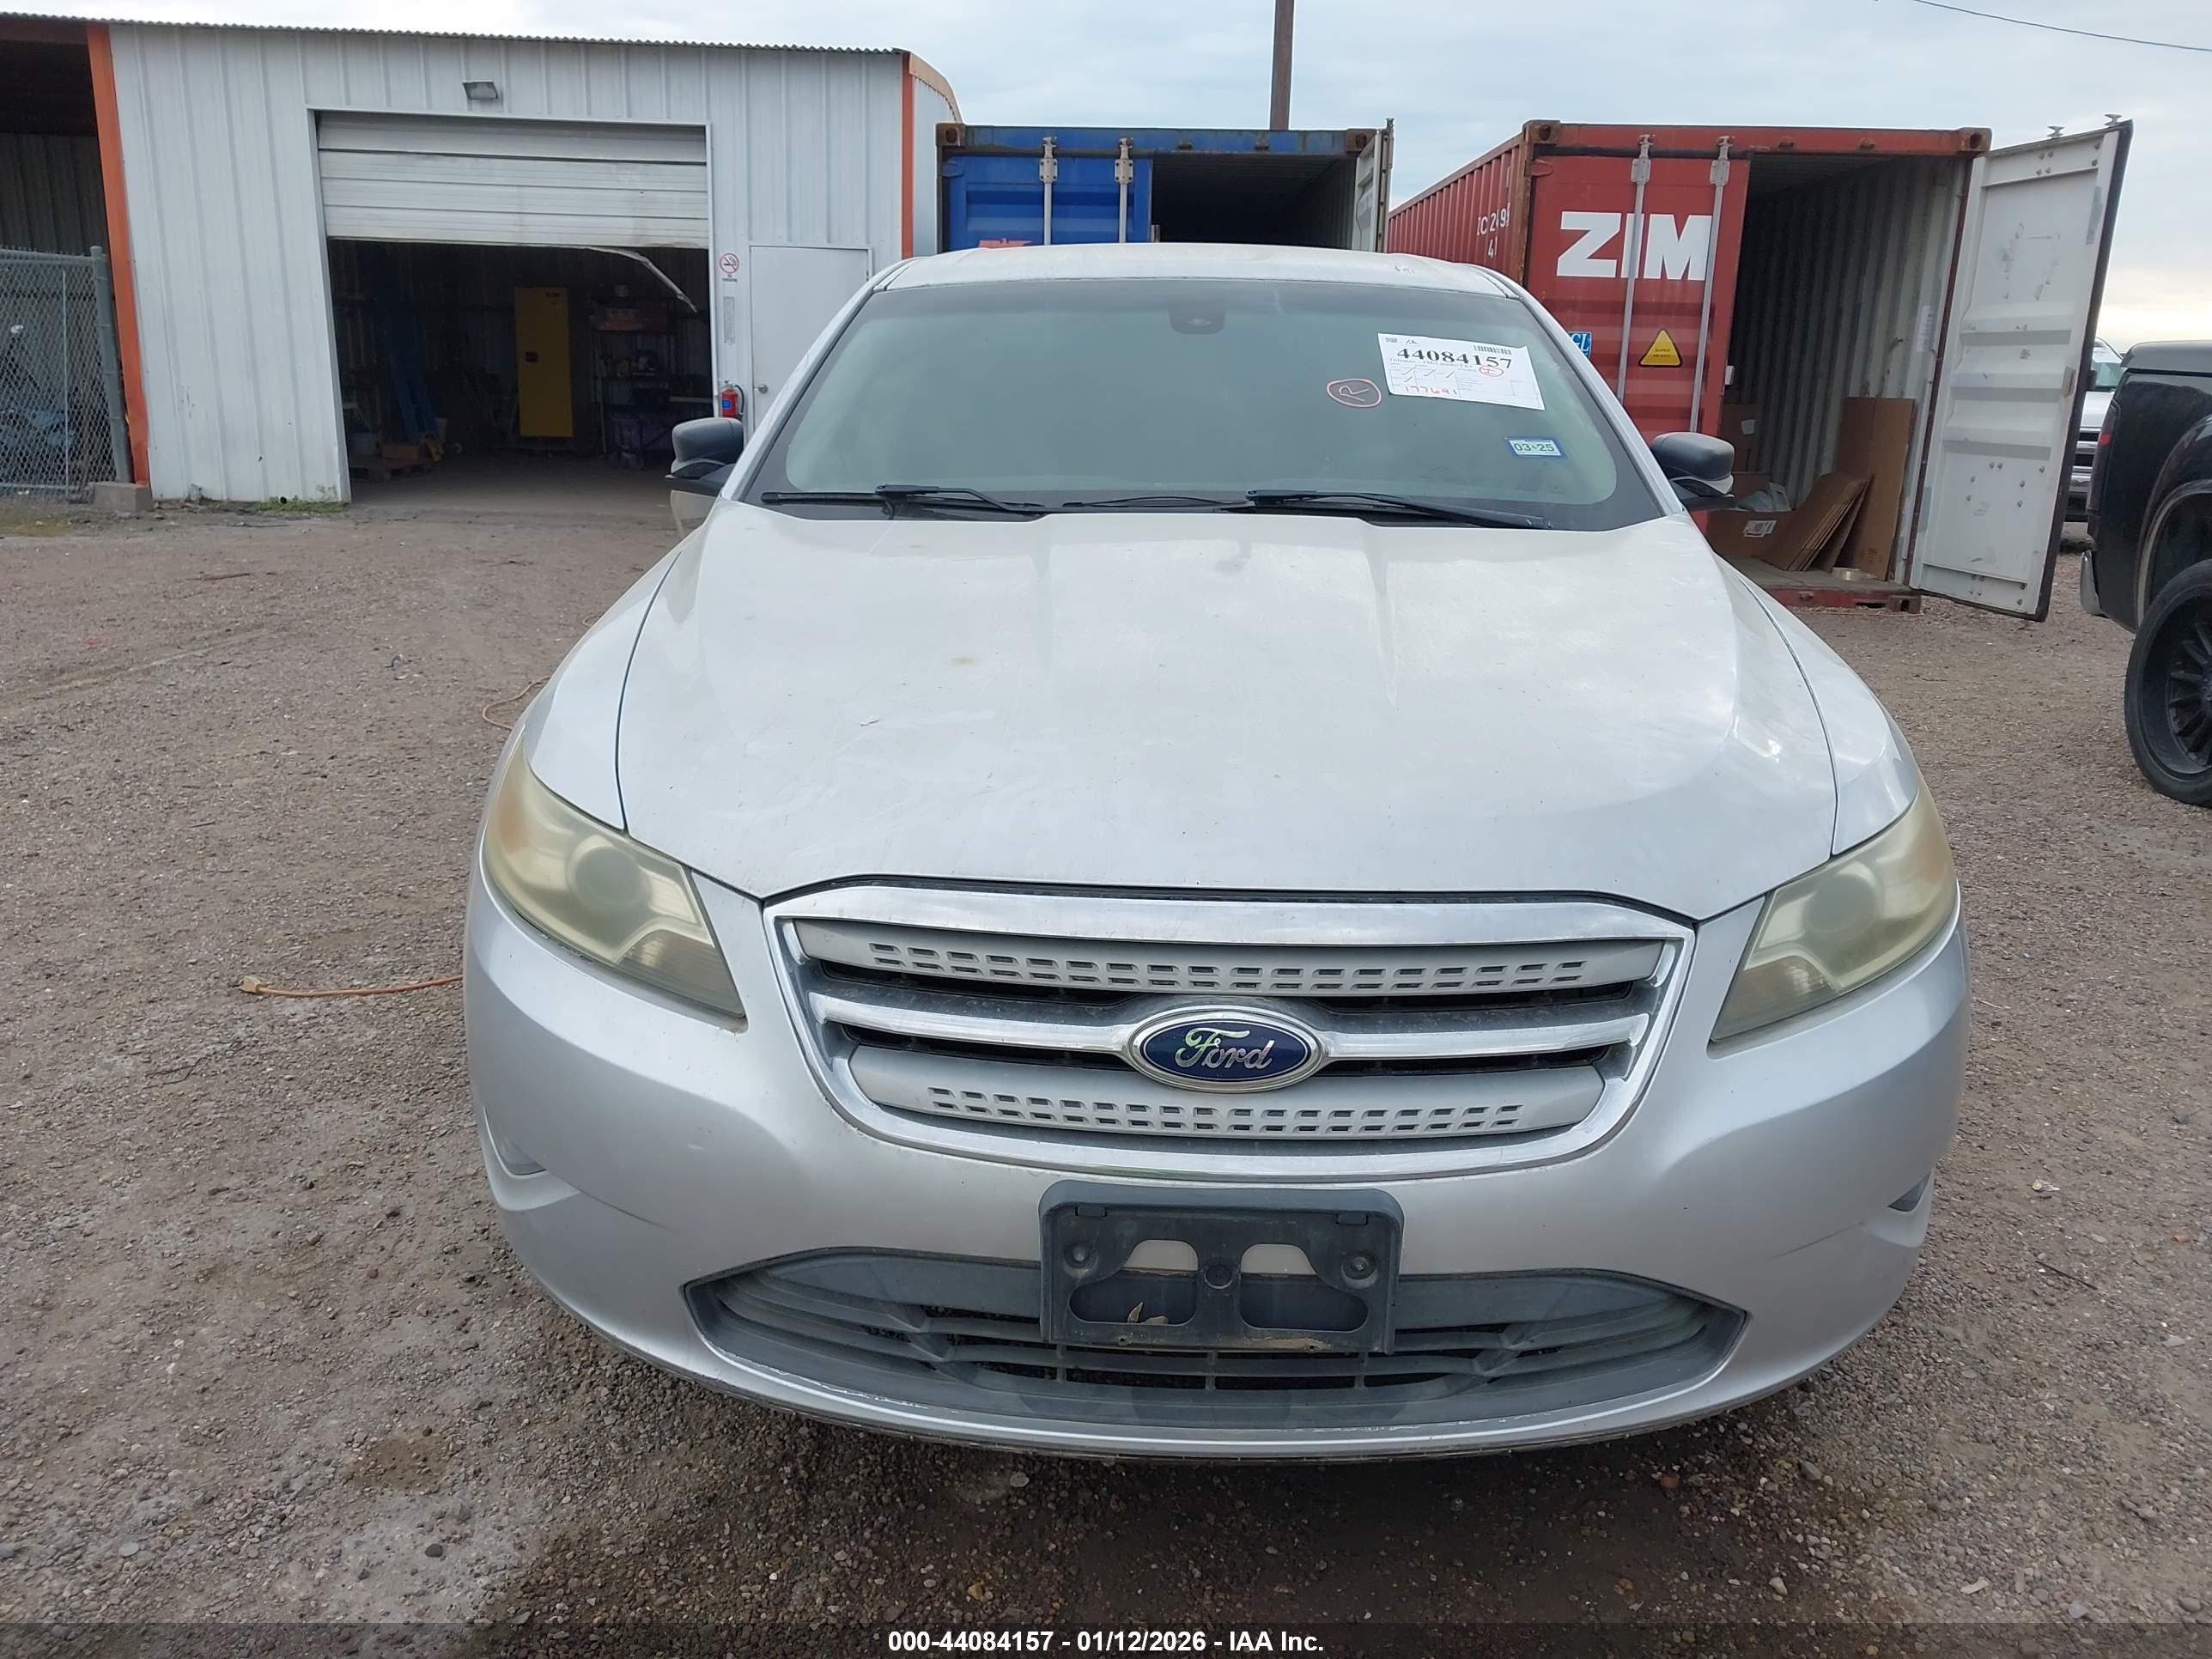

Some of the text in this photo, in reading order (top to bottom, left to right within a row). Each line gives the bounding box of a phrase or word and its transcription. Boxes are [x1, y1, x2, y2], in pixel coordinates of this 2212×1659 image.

[1557, 211, 1713, 281] ZIM
[1397, 348, 1512, 369] 44084157
[1175, 1027, 1275, 1069] Ford
